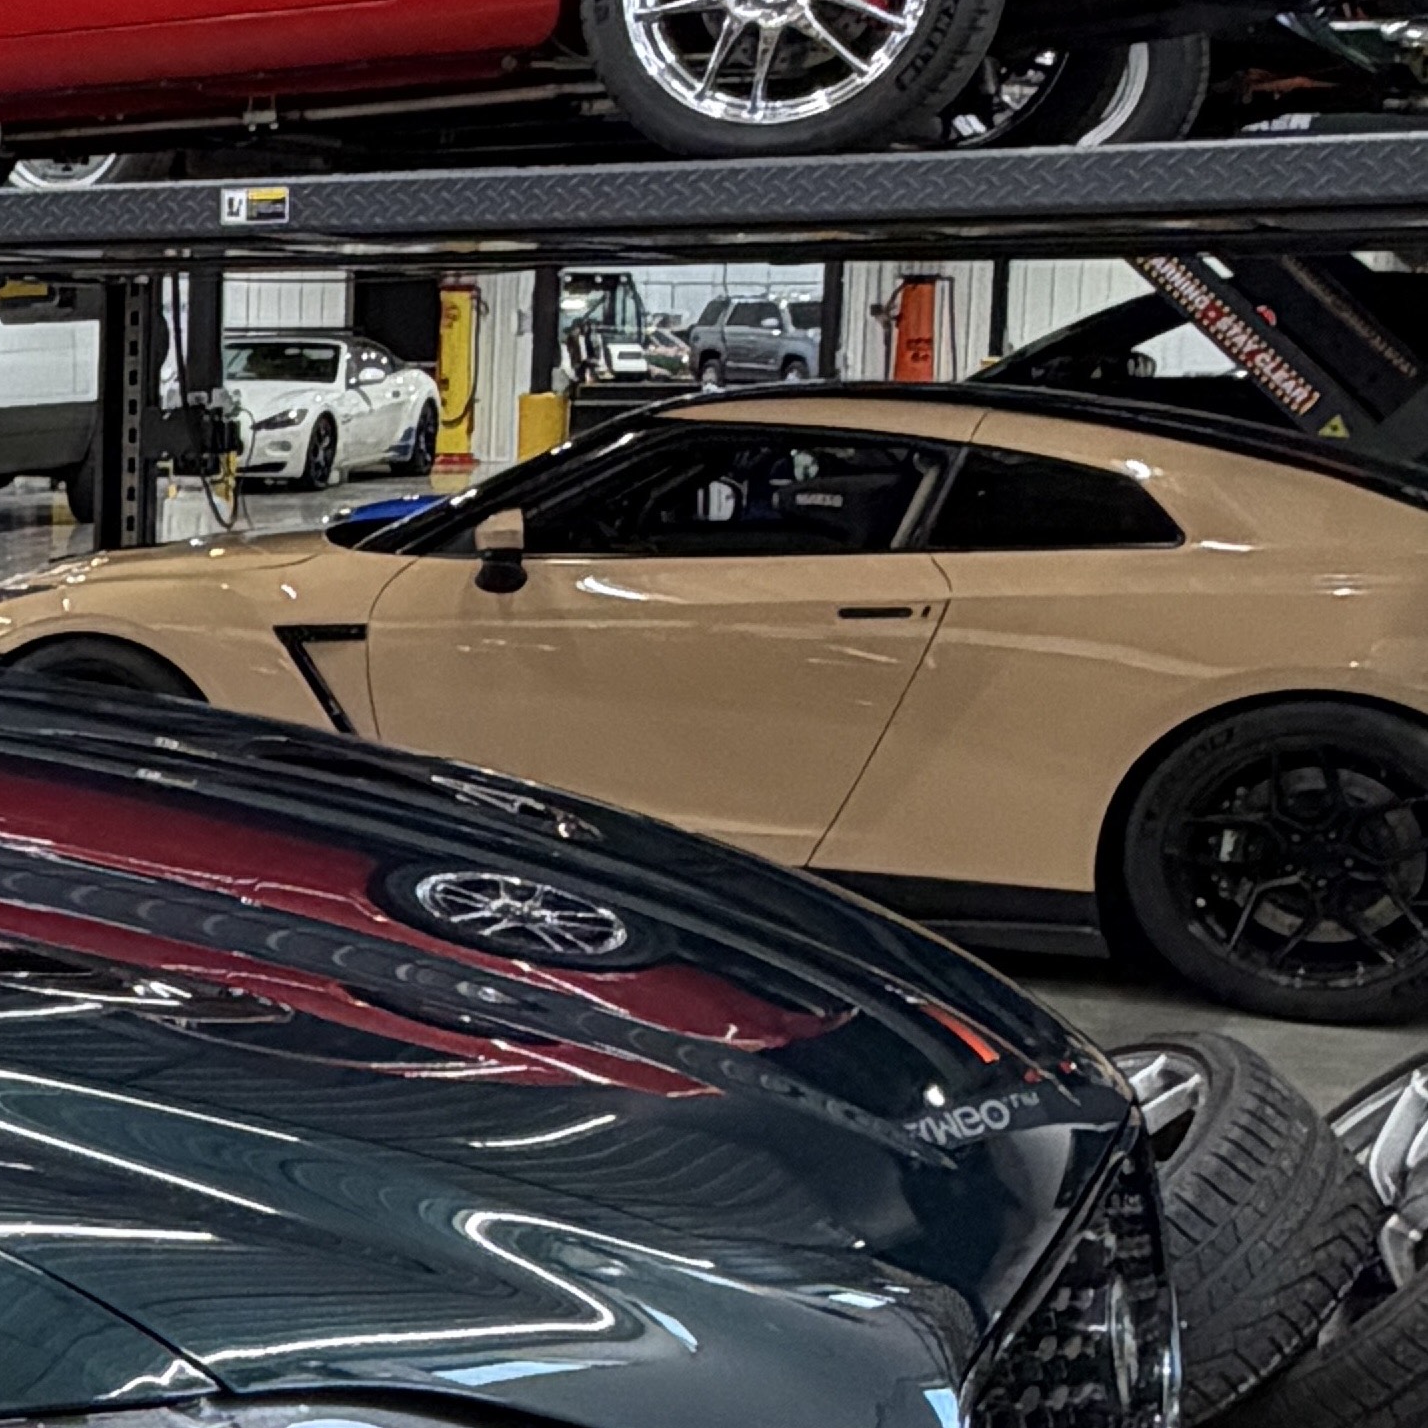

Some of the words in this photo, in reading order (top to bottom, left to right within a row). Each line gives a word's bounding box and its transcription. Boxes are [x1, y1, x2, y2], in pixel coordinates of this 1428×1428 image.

[1147, 254, 1211, 311] ARNING
[1215, 314, 1261, 356] STAY
[1252, 351, 1311, 405] CLEAR
